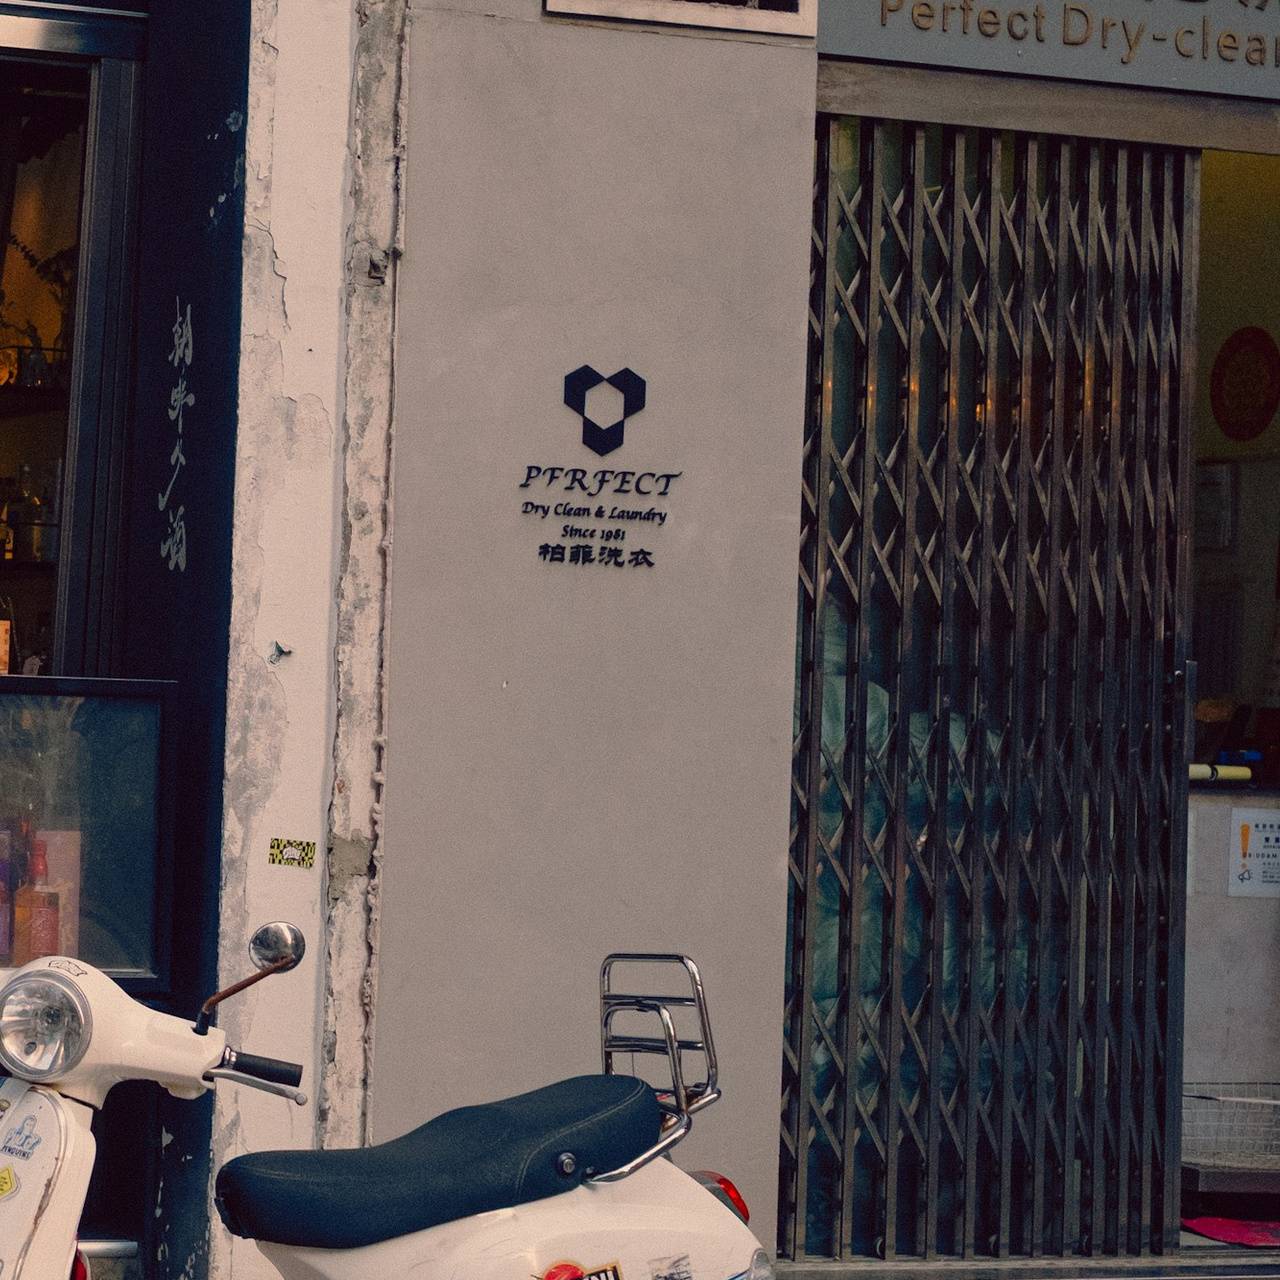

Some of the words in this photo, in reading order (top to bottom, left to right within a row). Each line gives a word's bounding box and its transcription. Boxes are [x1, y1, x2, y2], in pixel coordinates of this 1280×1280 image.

[1062, 2, 1280, 65] Dry-clea
[522, 501, 550, 519] Dry
[554, 503, 591, 518] Clean
[594, 505, 605, 518] &
[608, 506, 668, 526] Laundry
[561, 524, 597, 539] Since
